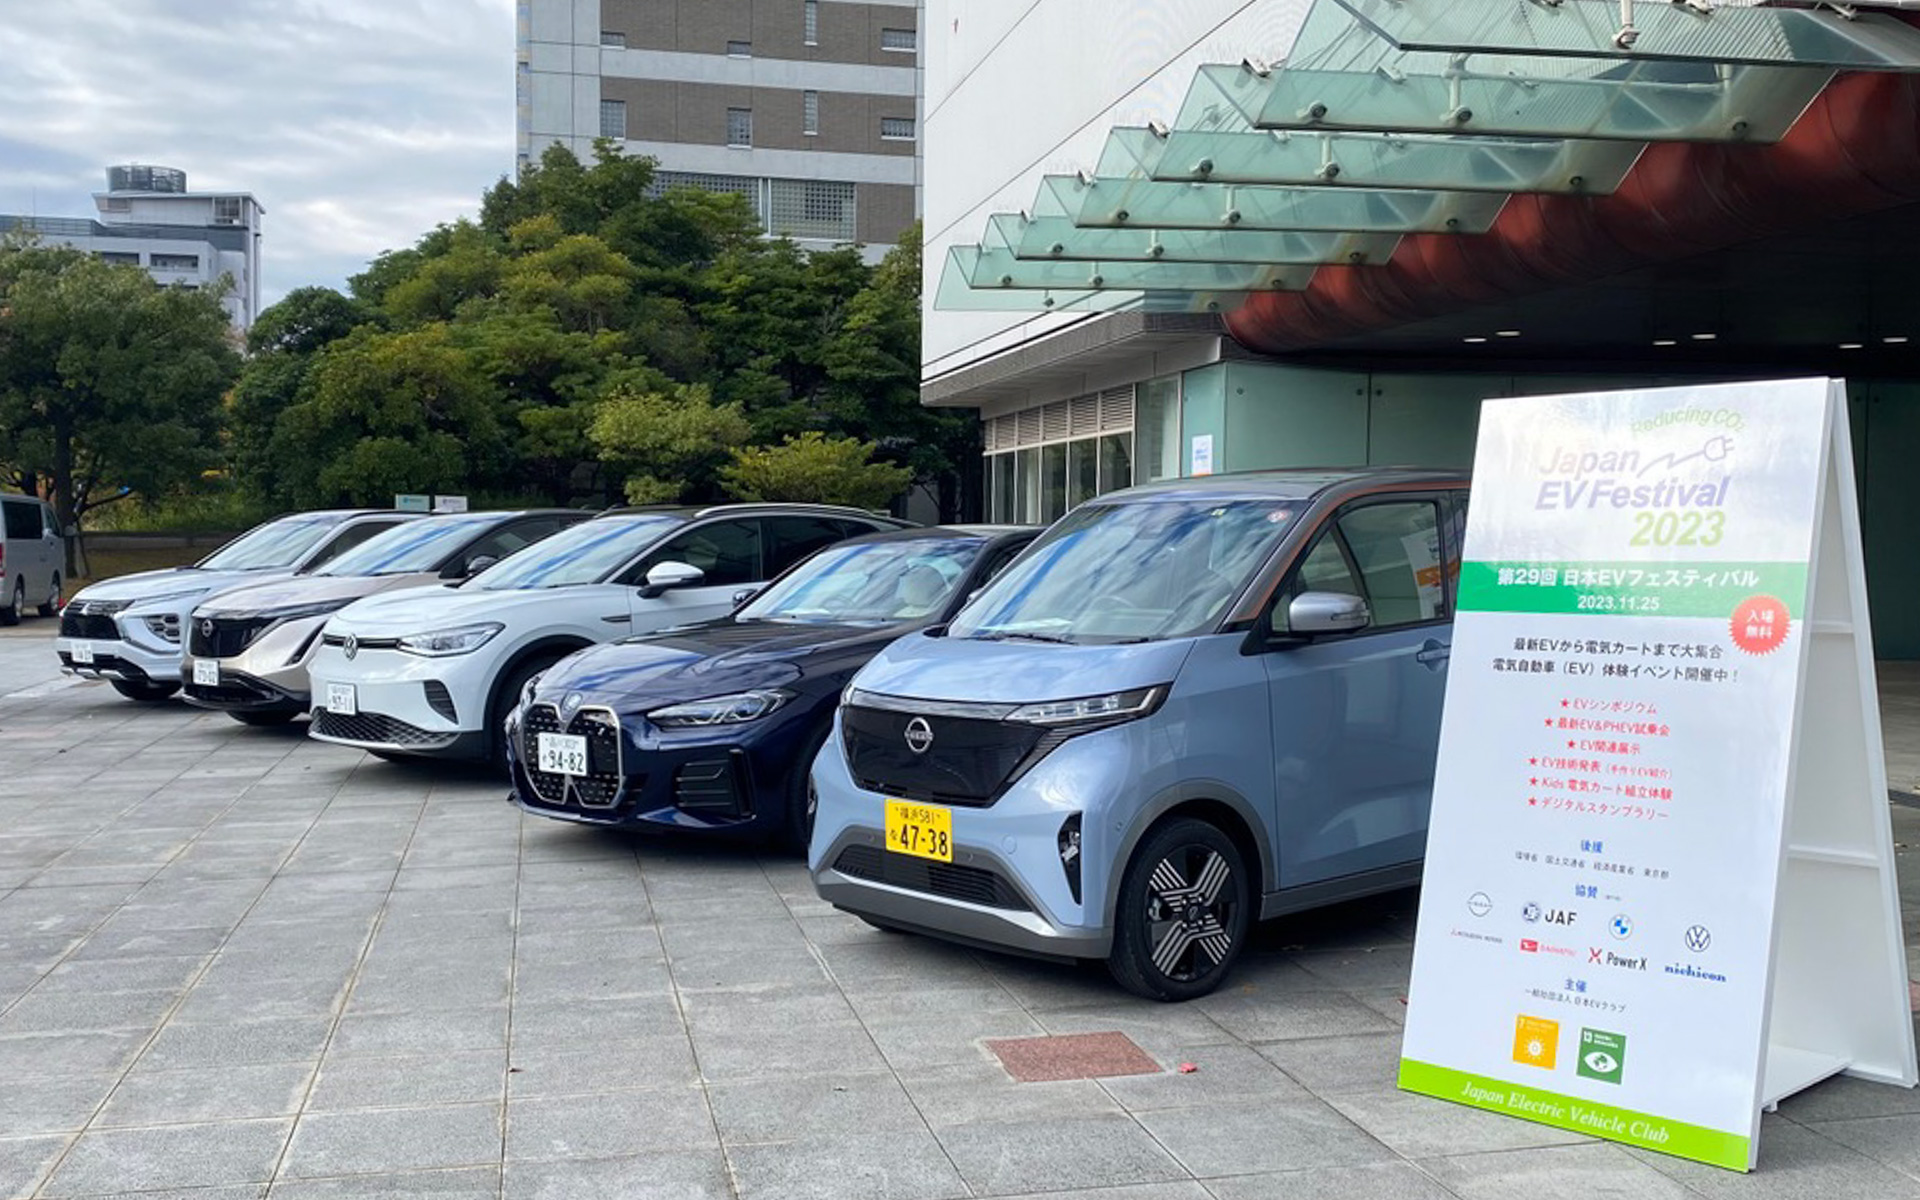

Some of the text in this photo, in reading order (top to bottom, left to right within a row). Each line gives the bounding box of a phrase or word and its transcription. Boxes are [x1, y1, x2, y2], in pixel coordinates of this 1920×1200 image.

[1631, 407, 1711, 433] Reducing
[1539, 447, 1639, 480] Japan
[1630, 511, 1725, 547] 2023
[1577, 594, 1660, 610] 2023.11.25
[1748, 610, 1774, 624] 入場
[1745, 626, 1772, 639] 無料
[1514, 638, 1723, 660] 最新EVから電気カートまで大集合
[1573, 699, 1657, 714] EVシンポジウム
[548, 749, 584, 772] 94-82
[1542, 797, 1668, 820] デジタルスタンプラリー
[901, 824, 947, 856] 47-38
[1545, 909, 1577, 925] JAF
[1665, 963, 1726, 982] nichicon
[1461, 1082, 1669, 1144] Japan Electric Vehicle Club
